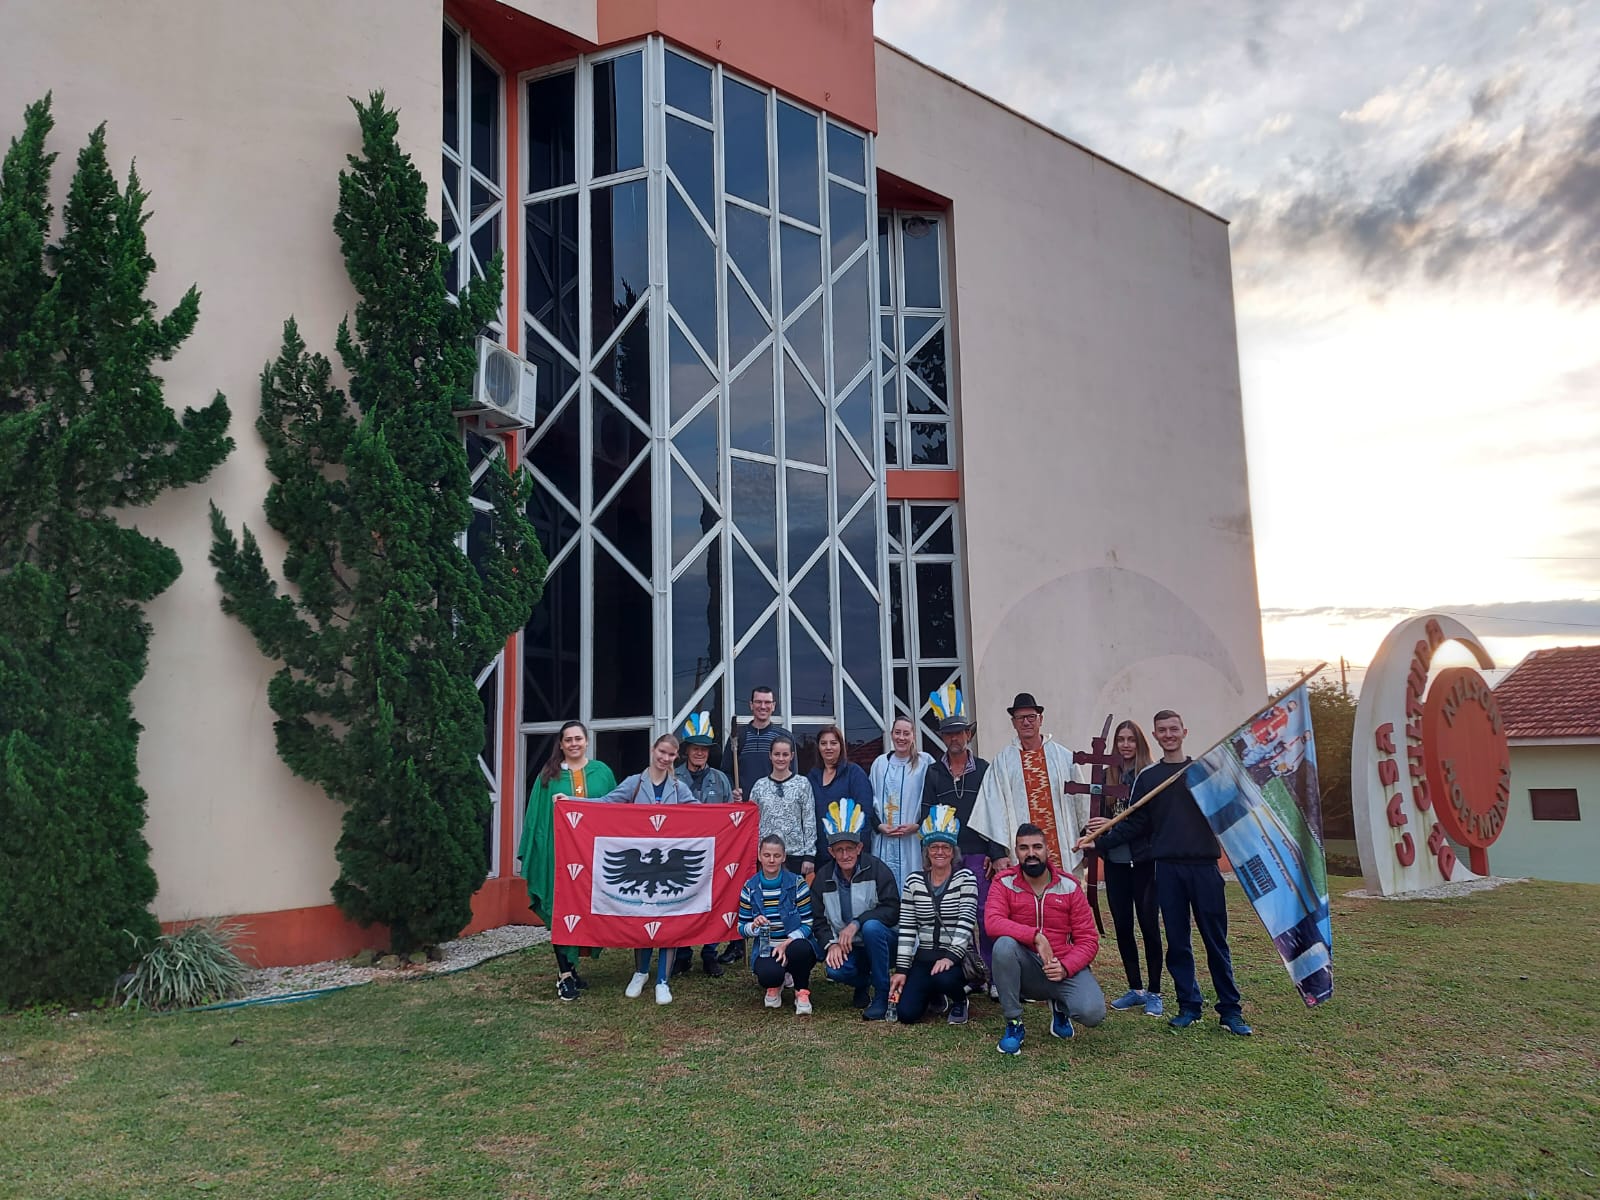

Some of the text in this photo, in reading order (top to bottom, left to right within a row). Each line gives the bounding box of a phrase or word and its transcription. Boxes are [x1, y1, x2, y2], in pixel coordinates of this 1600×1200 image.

[1406, 618, 1457, 881] DE CULTURA
[1441, 675, 1501, 735] NELSON
[1375, 722, 1415, 867] CASA
[1441, 758, 1512, 840] HOFFMANN
